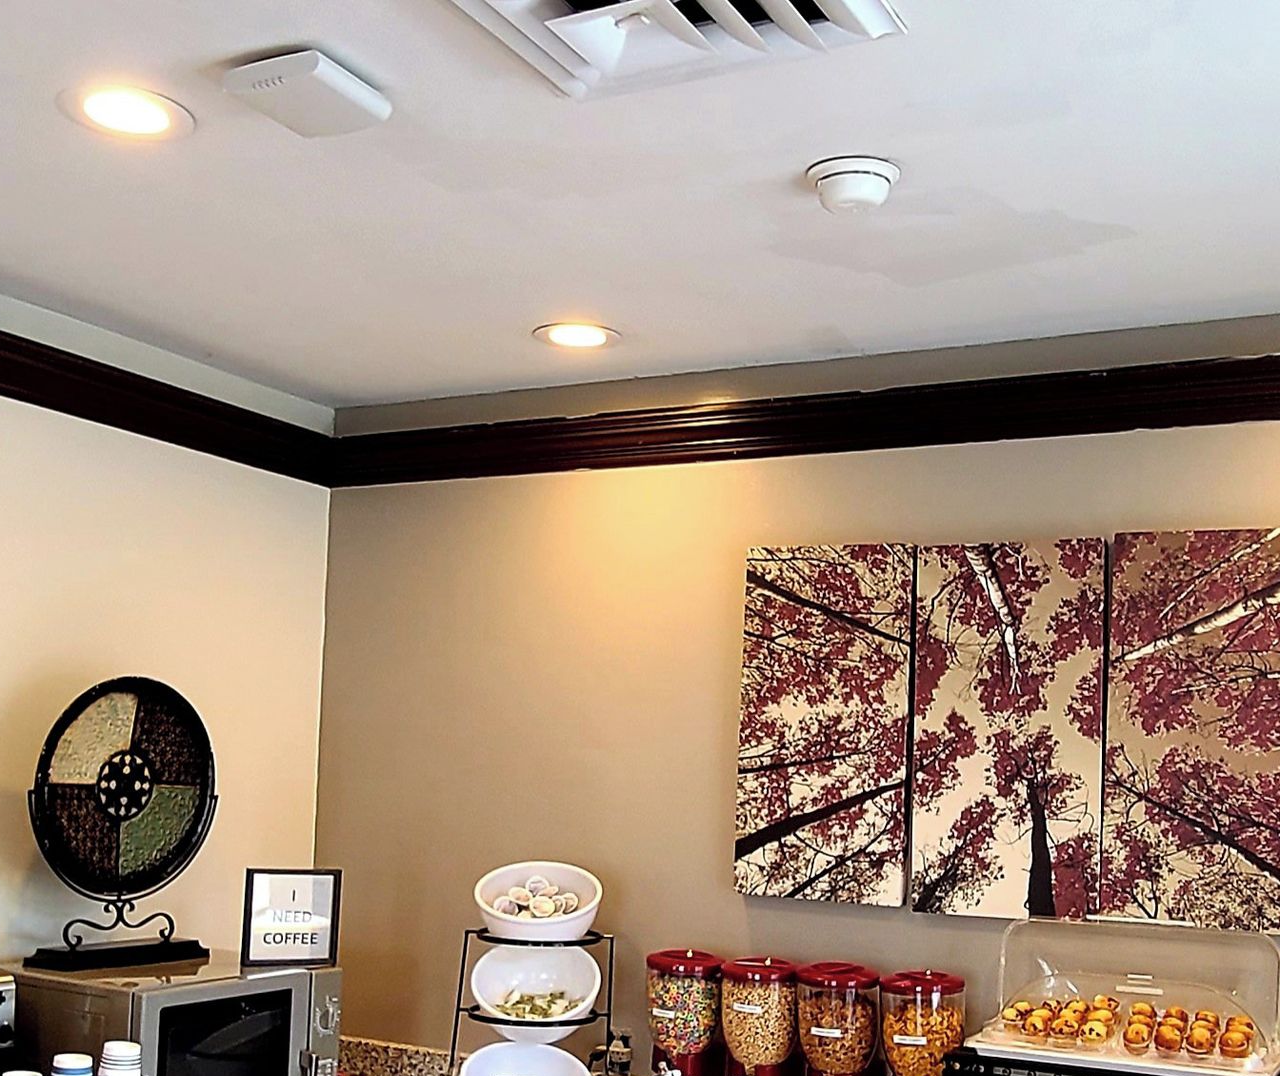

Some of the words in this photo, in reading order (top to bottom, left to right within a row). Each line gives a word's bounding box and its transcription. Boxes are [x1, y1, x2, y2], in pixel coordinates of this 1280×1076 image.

[291, 888, 296, 902] I
[272, 910, 313, 923] NEED
[263, 932, 319, 945] COFFEE
